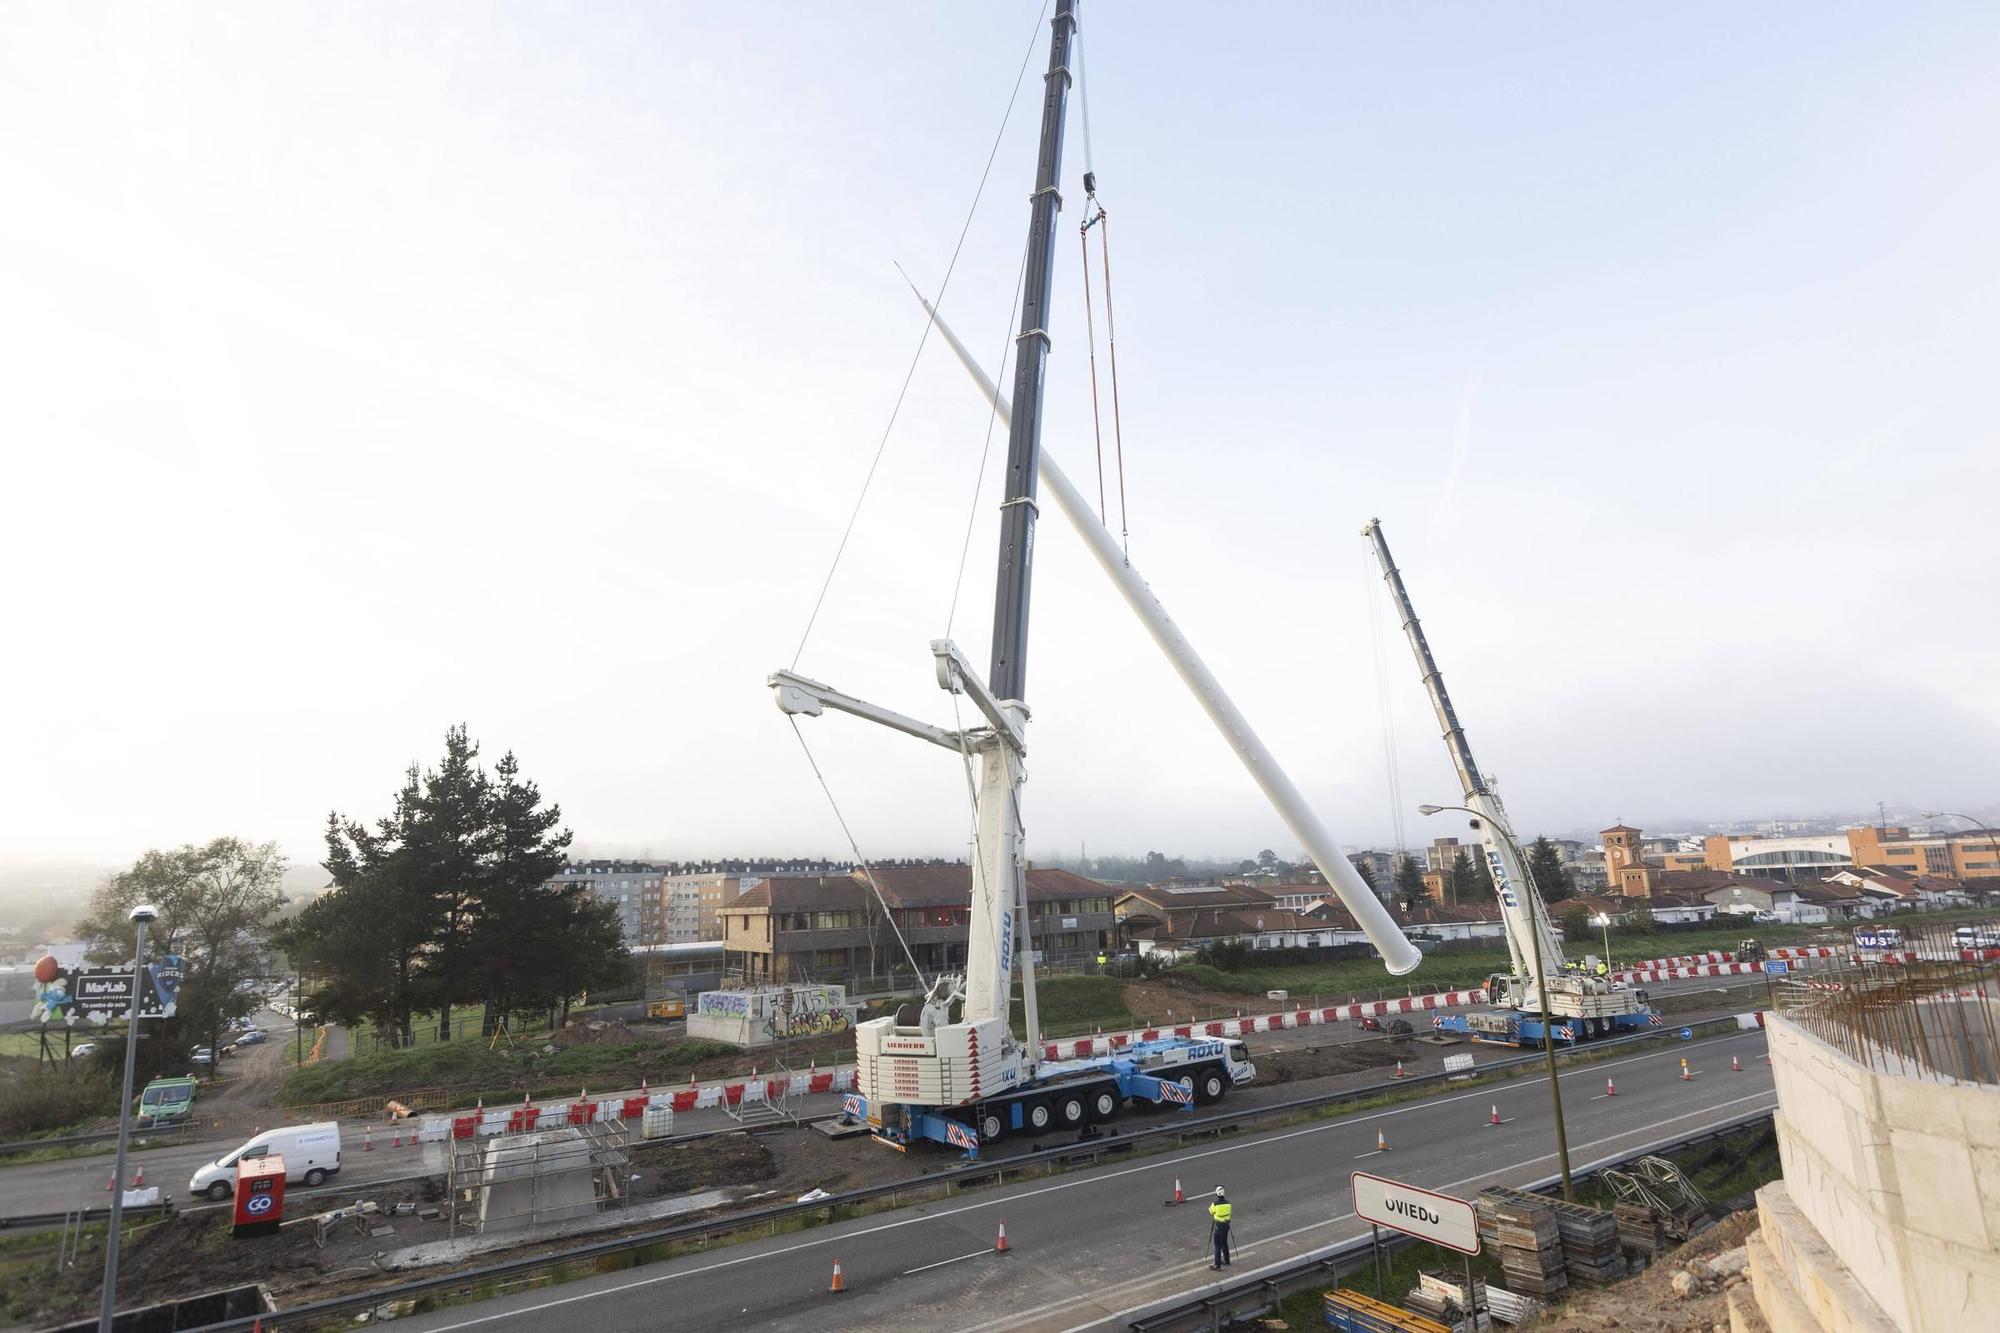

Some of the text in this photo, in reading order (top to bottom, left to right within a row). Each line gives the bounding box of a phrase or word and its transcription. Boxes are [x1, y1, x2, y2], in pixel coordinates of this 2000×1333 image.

[1001, 911, 1011, 972] ROXU
[1188, 1042, 1225, 1060] ROXU
[248, 1196, 271, 1211] GO
[1385, 1196, 1440, 1225] OVIEDO
